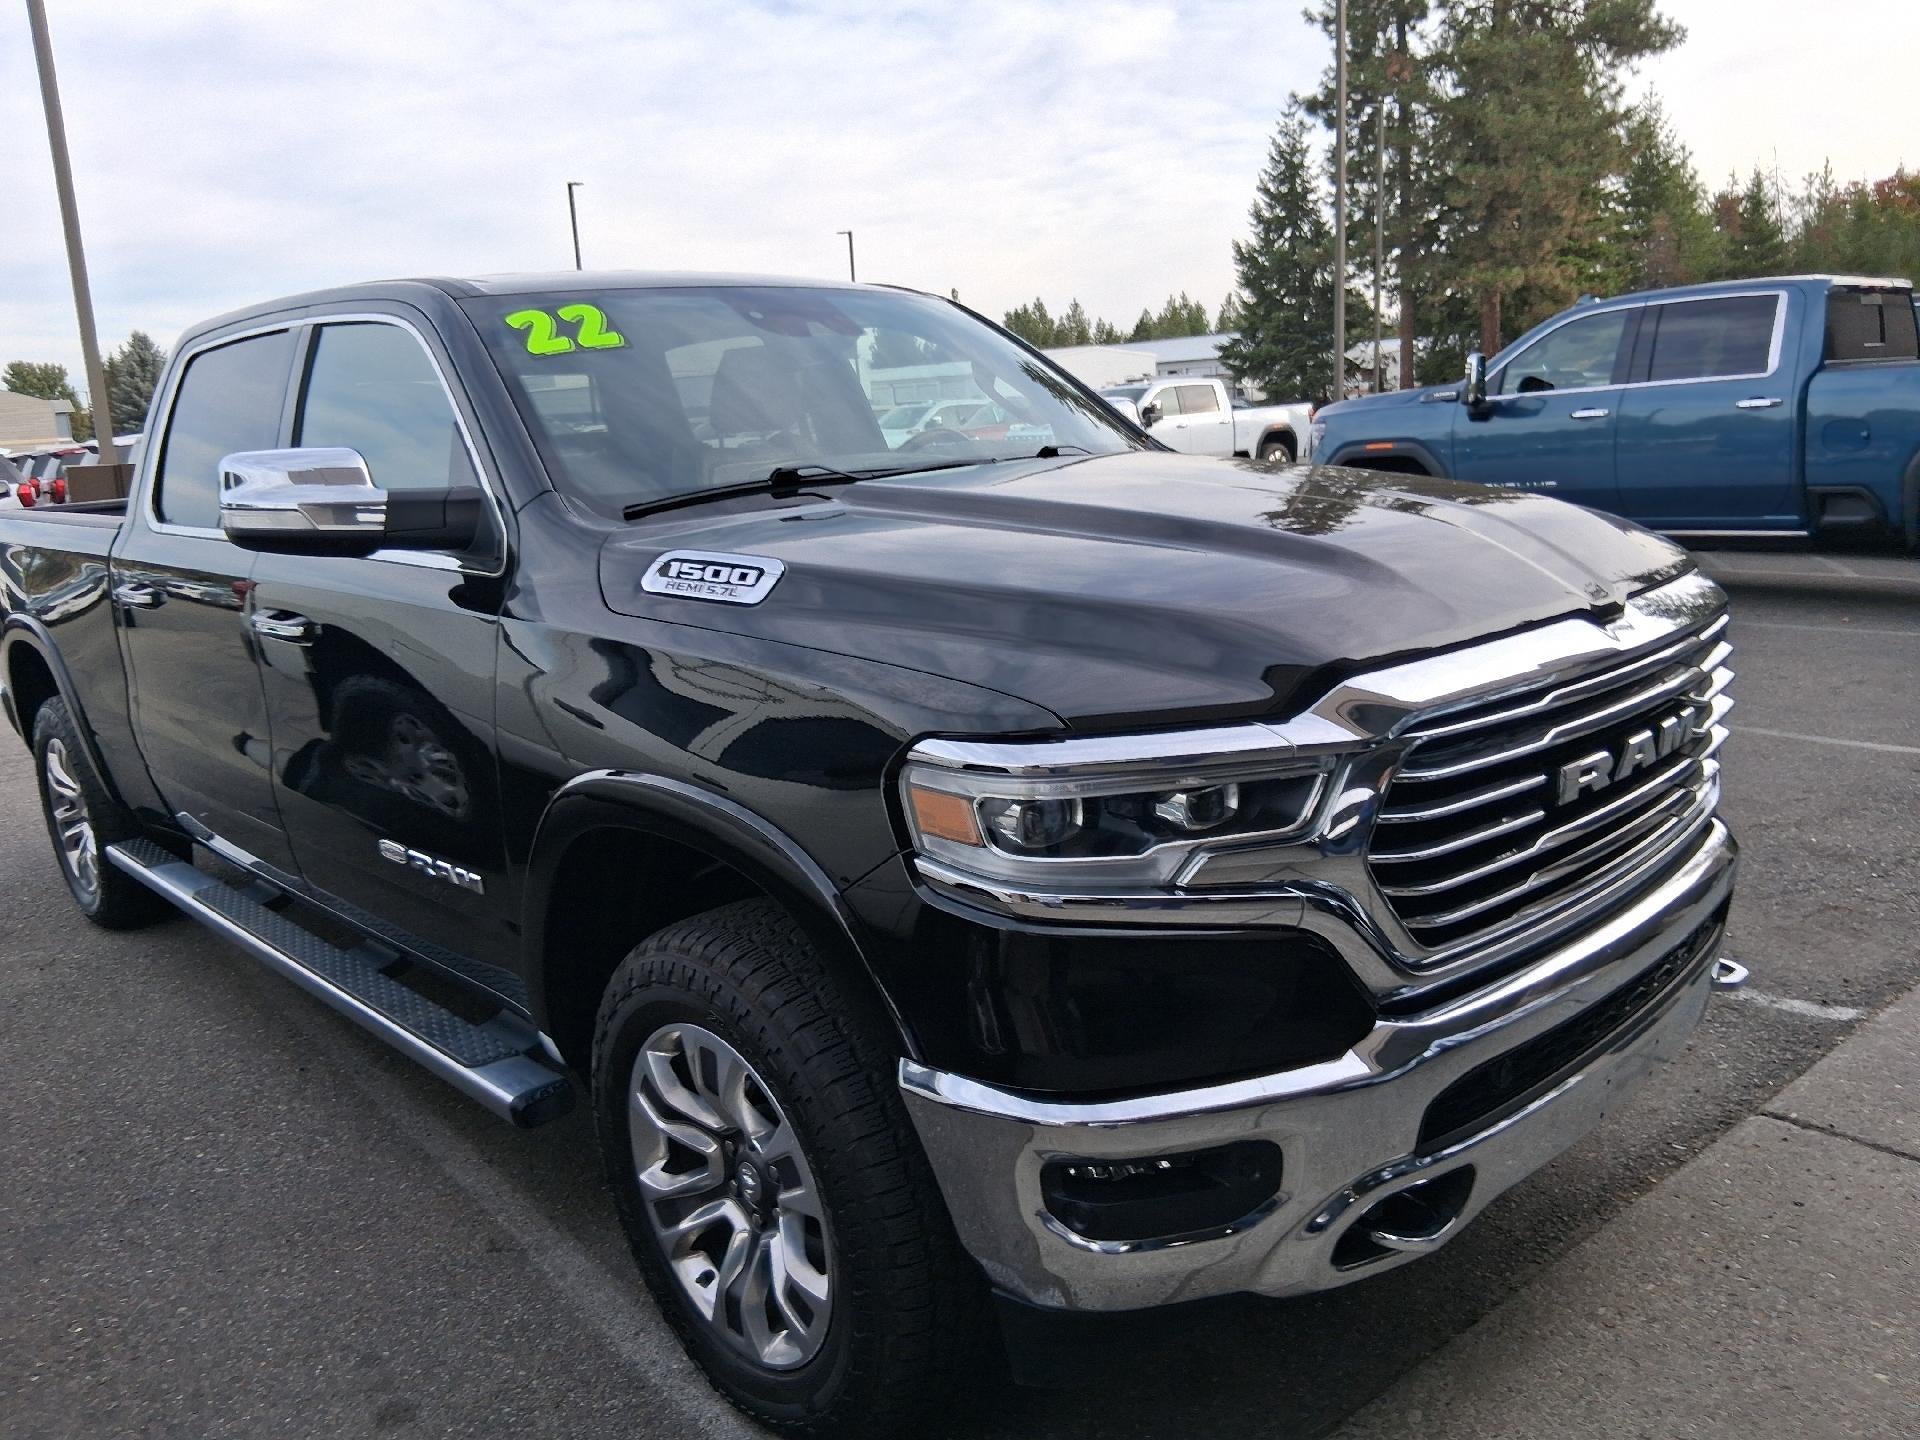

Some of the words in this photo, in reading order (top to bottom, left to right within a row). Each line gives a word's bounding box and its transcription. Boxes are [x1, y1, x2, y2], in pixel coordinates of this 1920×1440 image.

[505, 304, 625, 355] 22
[664, 580, 703, 593] HEMI
[706, 585, 738, 597] 5.7L
[668, 561, 761, 585] 1500
[1558, 706, 1696, 807] RAM
